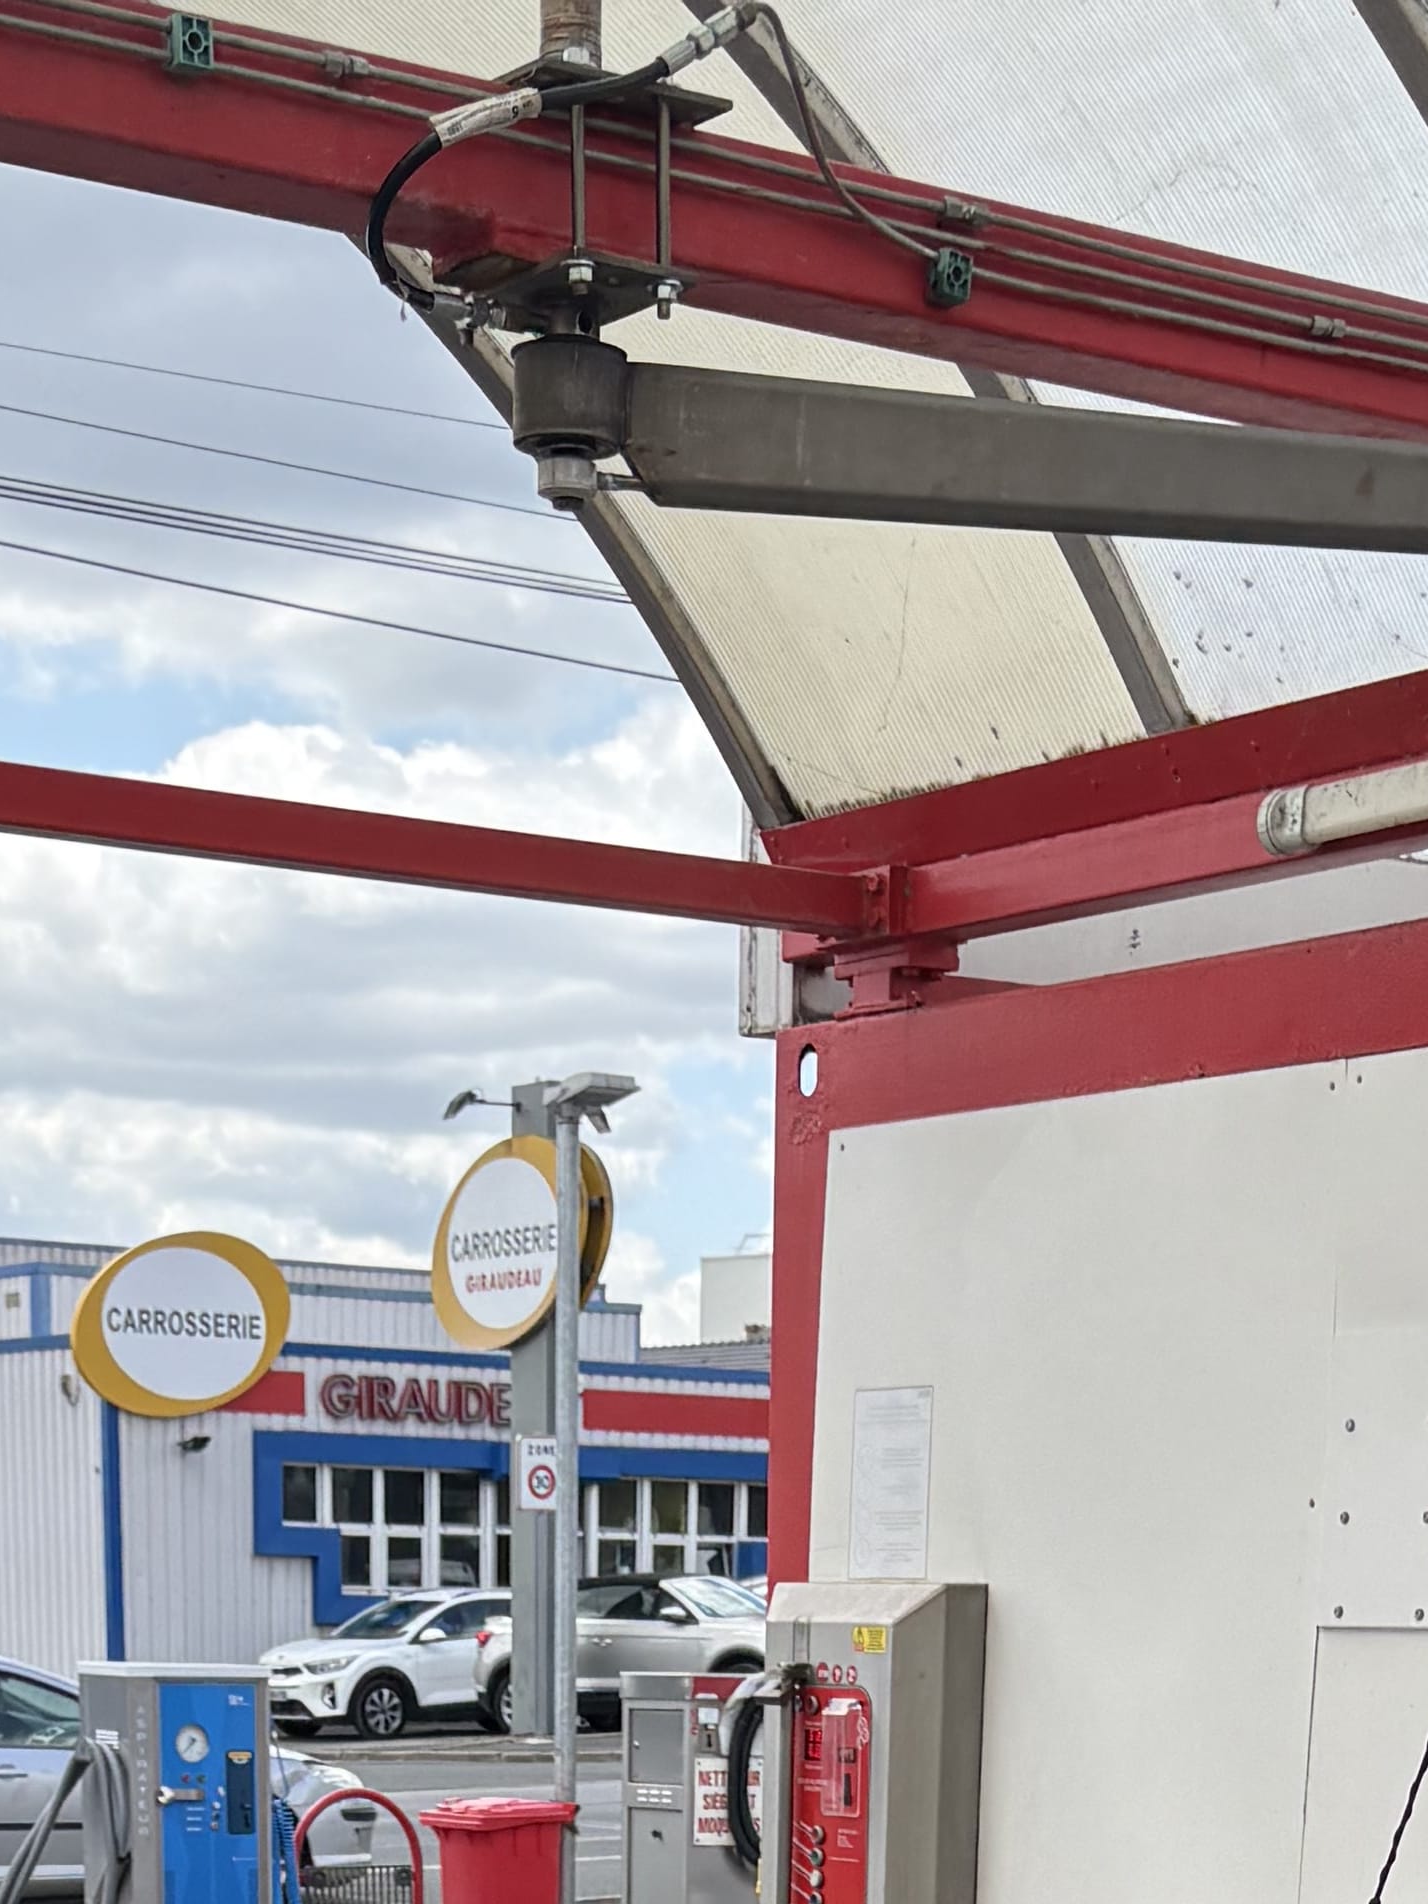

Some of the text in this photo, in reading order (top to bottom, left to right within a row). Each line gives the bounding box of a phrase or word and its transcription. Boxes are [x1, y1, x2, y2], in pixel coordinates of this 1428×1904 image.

[452, 1223, 557, 1262] CARROSSERIE
[465, 1267, 542, 1293] GIRAUDEAU
[106, 1307, 262, 1340] CARROSSERIE
